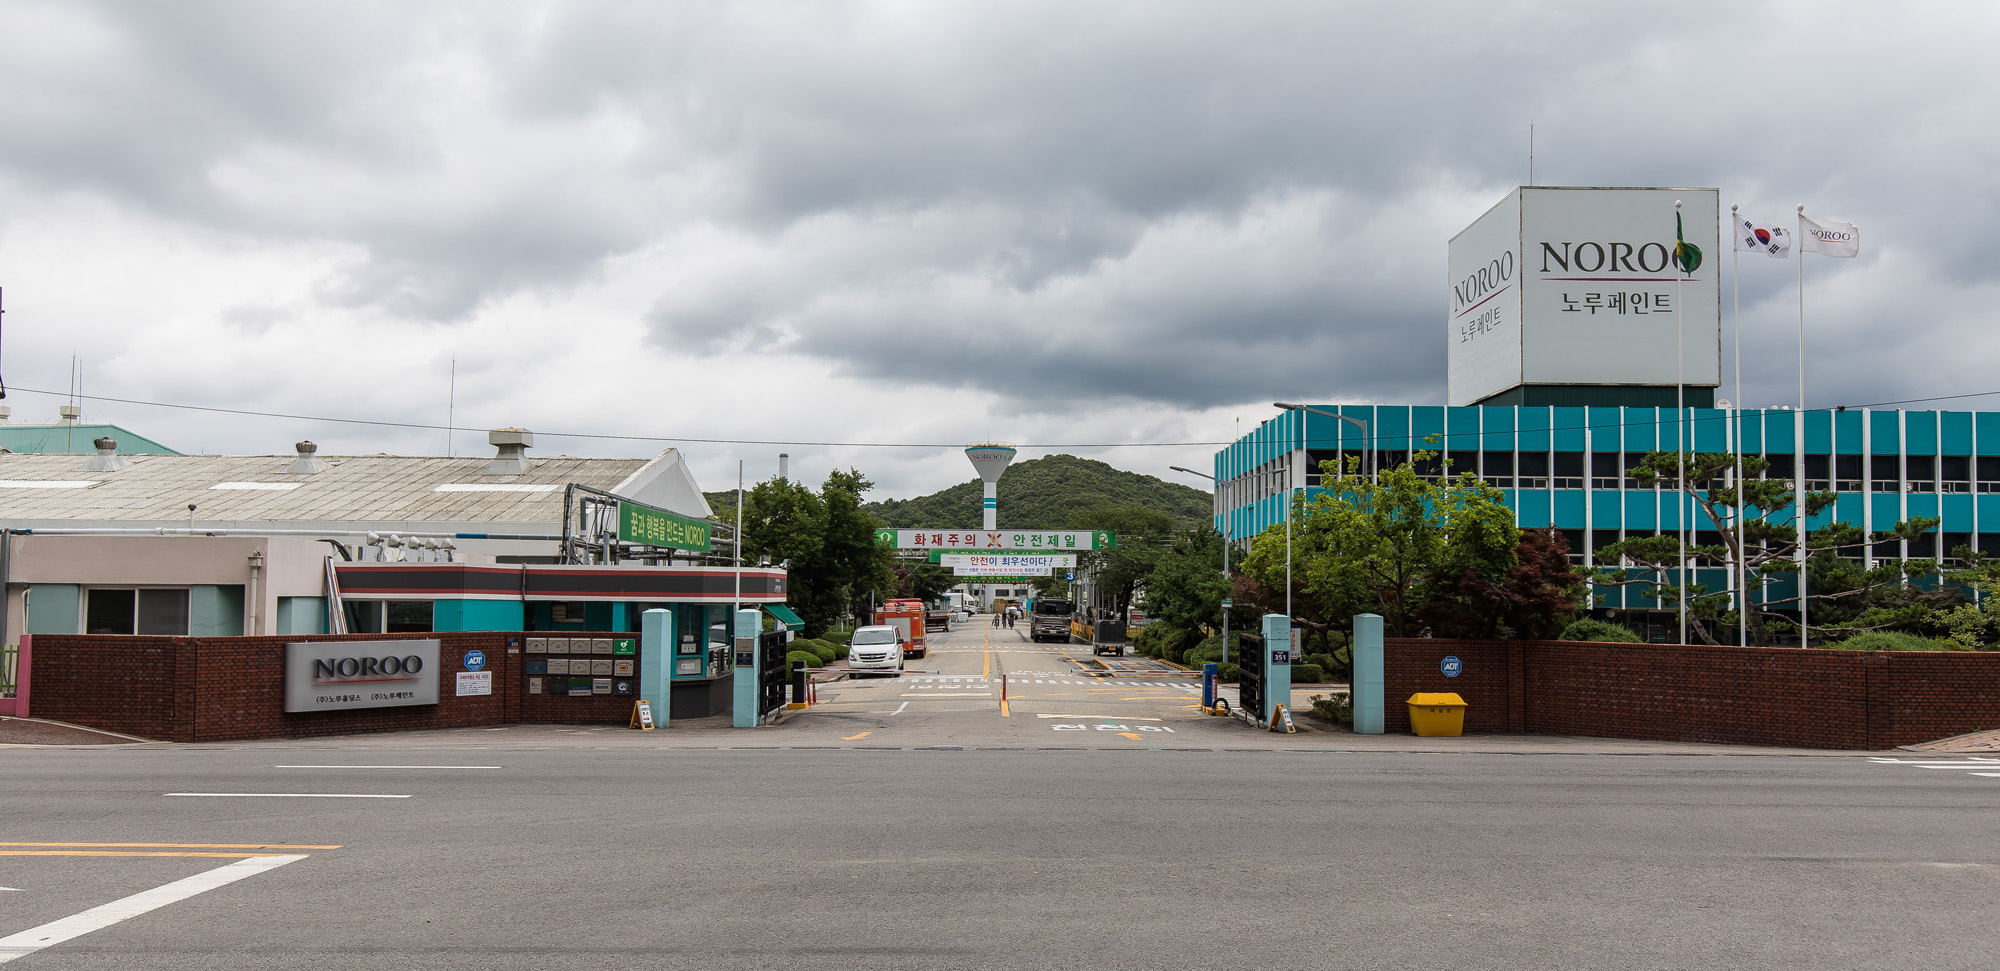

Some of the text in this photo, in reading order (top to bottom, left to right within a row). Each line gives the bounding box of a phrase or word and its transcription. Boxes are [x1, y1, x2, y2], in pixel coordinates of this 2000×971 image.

[1809, 228, 1851, 241] NOROO
[1453, 250, 1514, 313] NOROO
[1561, 291, 1673, 316] 노루페인트
[1460, 306, 1502, 344] 노루페인트
[973, 453, 1002, 461] NOROO
[630, 511, 705, 547] 꿈과 행복을 만드는 NOROO
[914, 533, 1076, 548] 화재주의 안전제일
[970, 556, 997, 566] 안전이
[1067, 572, 1074, 580] 3
[313, 655, 424, 679] NOROO
[467, 656, 483, 665] ADT
[1444, 662, 1459, 671] ADT
